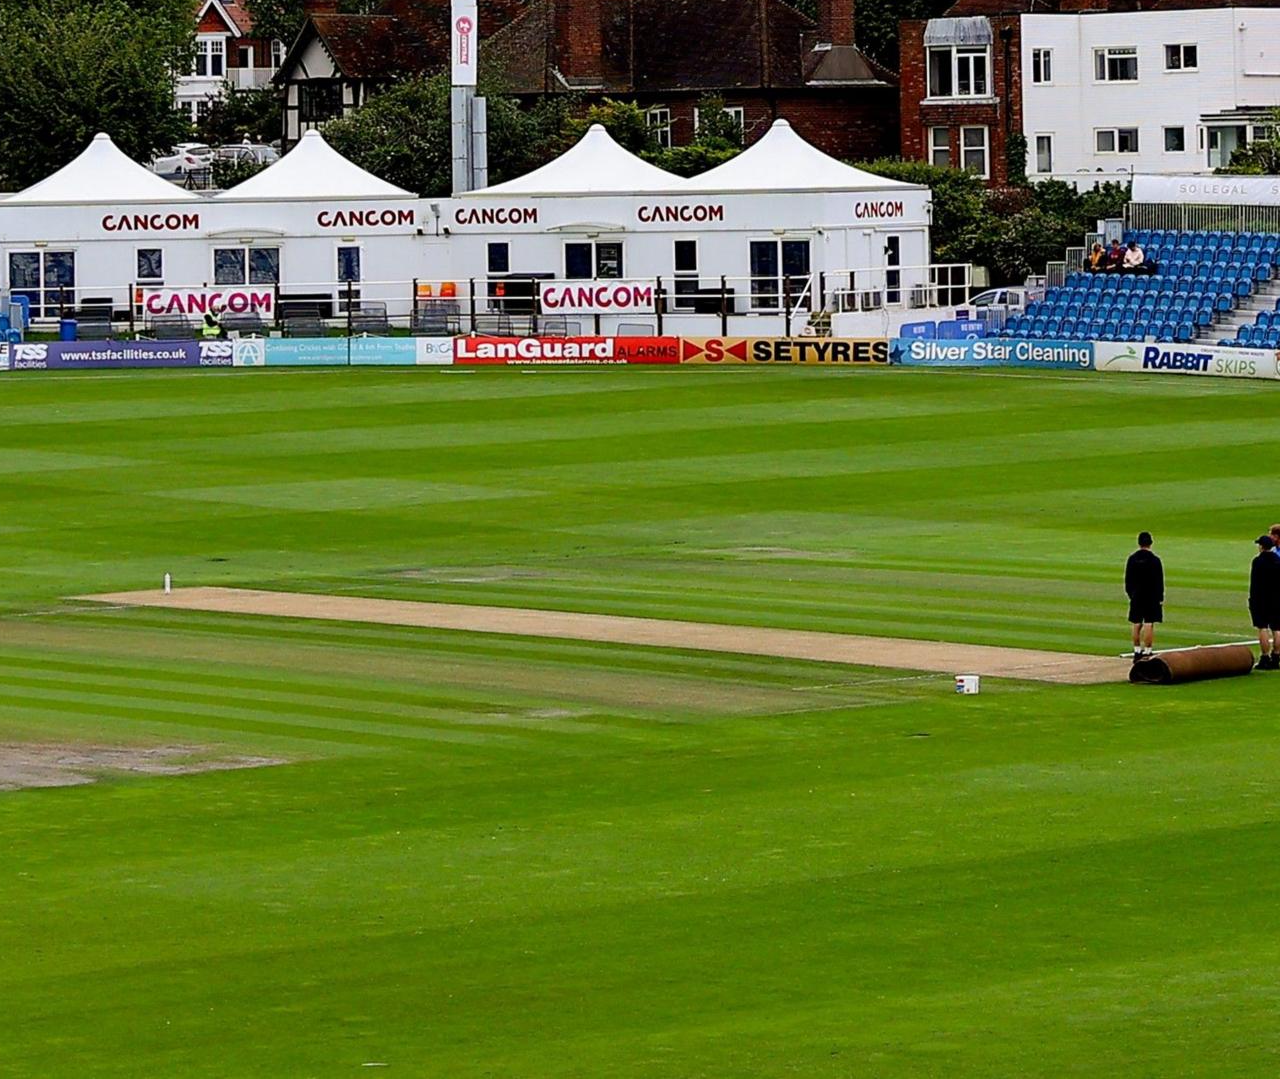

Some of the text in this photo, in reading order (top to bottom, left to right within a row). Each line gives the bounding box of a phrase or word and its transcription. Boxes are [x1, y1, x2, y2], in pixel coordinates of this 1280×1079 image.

[1179, 185, 1248, 194] SO LEGAL
[455, 208, 537, 224] CANCOM
[638, 205, 723, 221] CANCOM
[855, 202, 903, 218] CANCOM
[102, 214, 199, 231] CANCOM
[318, 210, 414, 227] CANCOM
[146, 292, 271, 315] CANCOM
[543, 285, 651, 310] CANCOM
[13, 344, 48, 359] TSS
[61, 349, 186, 361] www.tssfacilities.co.uk
[198, 341, 232, 356] TSS
[457, 338, 678, 359] LanGuard ALARMS
[753, 341, 888, 363] SETYRES
[910, 341, 1090, 367] Silver Star Cleaning
[14, 360, 47, 368] facilities
[200, 357, 232, 365] facilities
[1216, 358, 1256, 376] SKIPS
